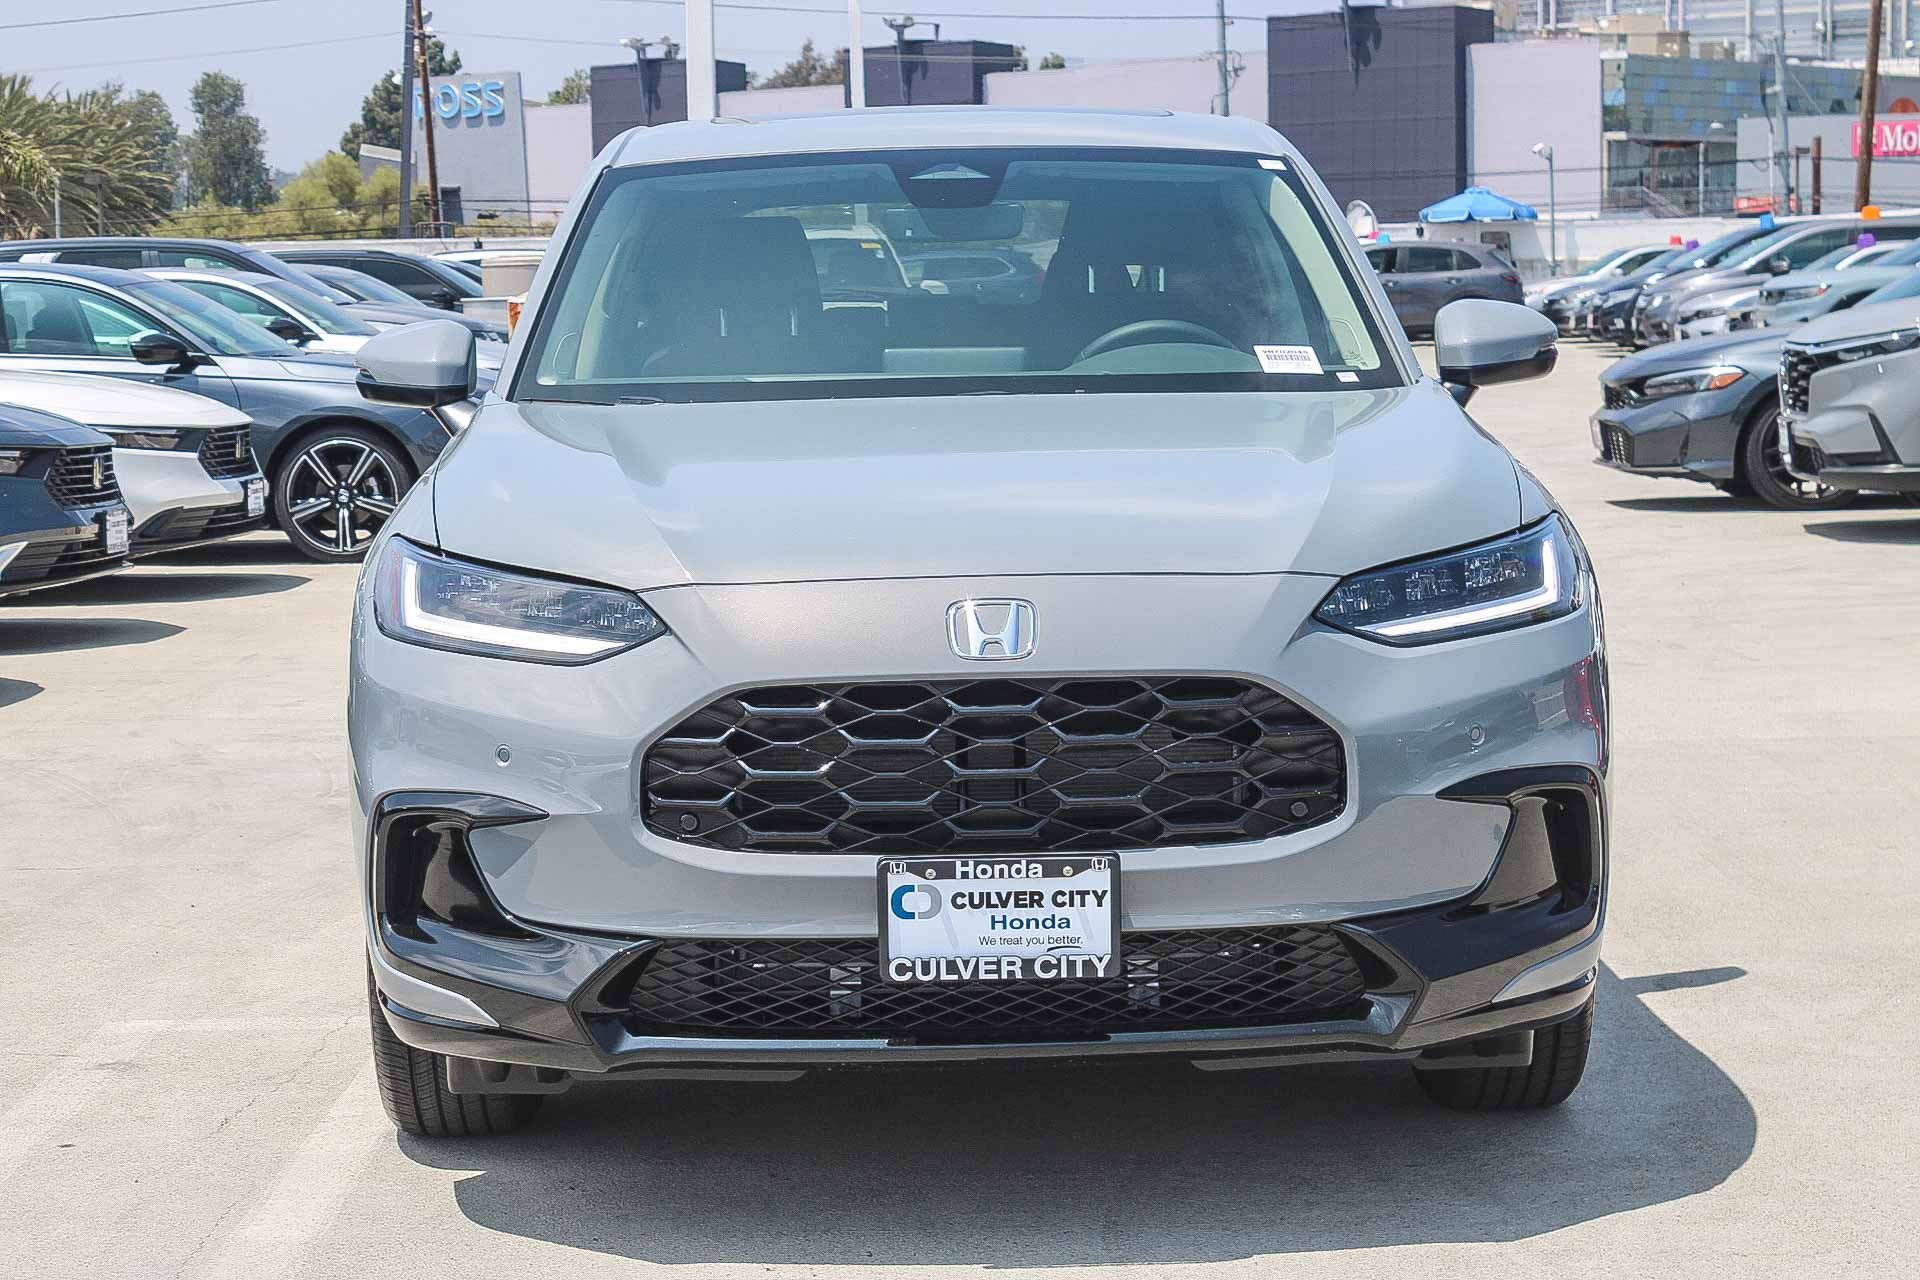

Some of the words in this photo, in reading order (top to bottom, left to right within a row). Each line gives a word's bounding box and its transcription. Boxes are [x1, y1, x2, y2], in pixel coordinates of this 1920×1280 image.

[1882, 124, 1920, 151] Mo
[955, 860, 1043, 879] Honda
[951, 891, 1044, 909] CULVER
[1051, 889, 1108, 908] CITY
[990, 914, 1071, 930] Honda
[978, 935, 997, 945] We
[999, 935, 1022, 945] treat
[1025, 937, 1045, 948] you
[1048, 934, 1083, 945] better.
[888, 956, 1023, 981] CULVER
[1034, 954, 1111, 979] CITY
